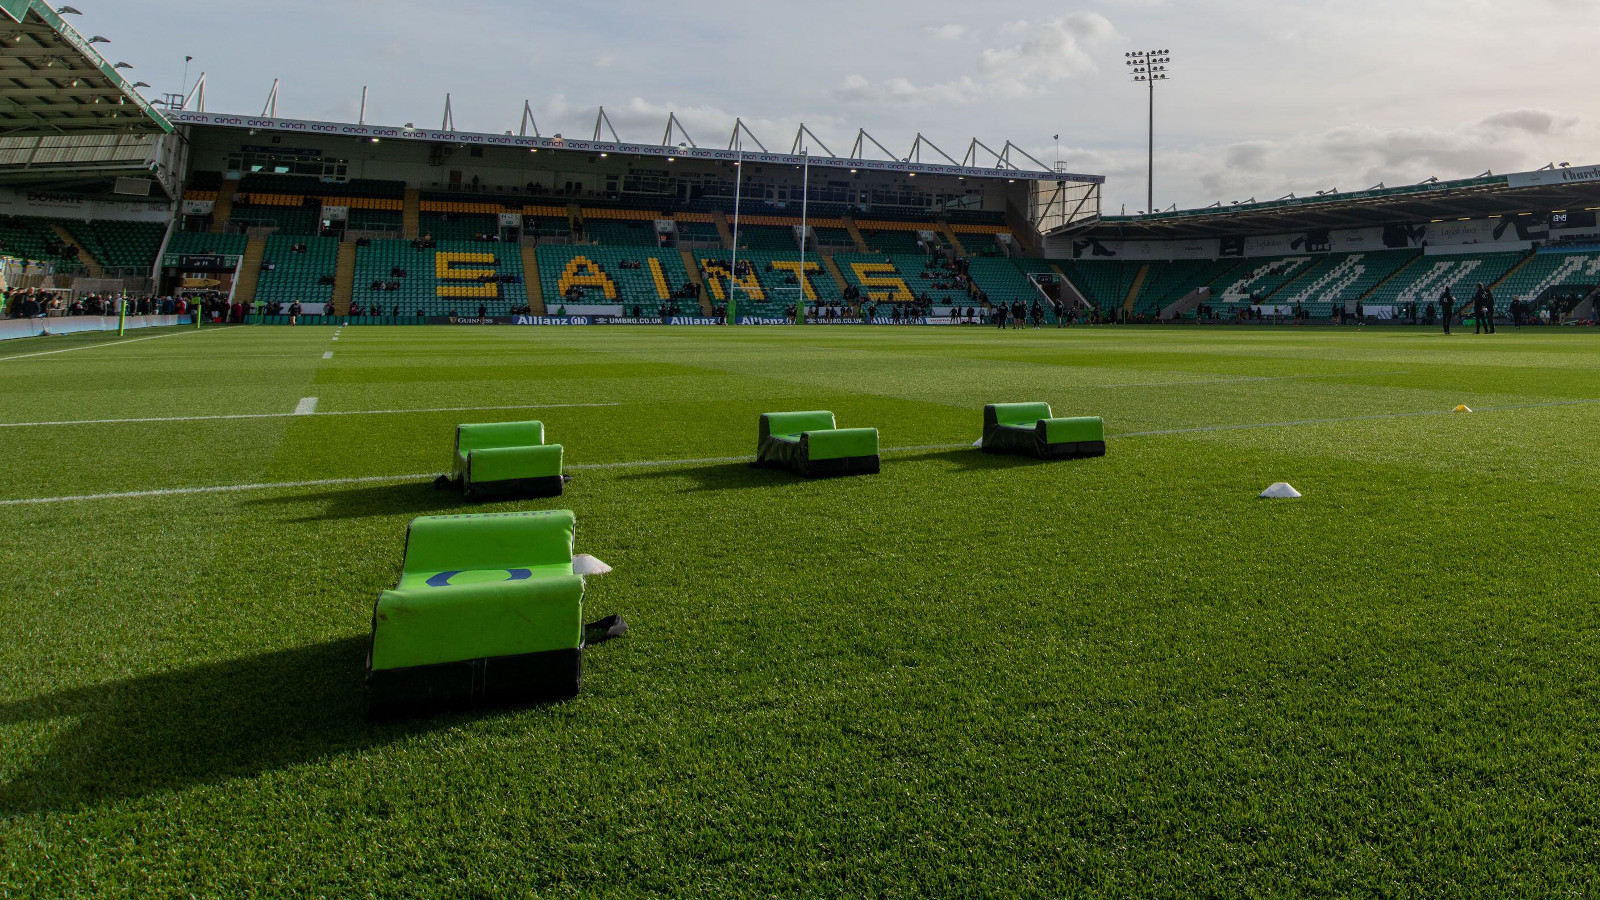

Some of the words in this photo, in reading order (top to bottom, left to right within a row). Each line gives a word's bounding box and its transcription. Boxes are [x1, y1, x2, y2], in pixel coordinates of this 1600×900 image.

[180, 114, 208, 122] cinch
[214, 116, 242, 125] cinch
[247, 119, 274, 128] cinch
[280, 121, 306, 130] cinch
[311, 124, 337, 132] cinch
[342, 126, 368, 135] cinch
[373, 129, 398, 137] cinch
[402, 131, 427, 139] cinch
[487, 136, 511, 144] cinch
[515, 138, 537, 146] cinch
[541, 139, 564, 147] cinch
[568, 141, 590, 149] cinch
[593, 143, 615, 151] cinch
[619, 145, 640, 153] cinch
[643, 146, 664, 154] cinch
[667, 148, 688, 156] cinch
[715, 151, 734, 159] cinch
[517, 316, 568, 325] Allianz
[670, 316, 716, 325] Allianz
[741, 316, 784, 325] Allianz
